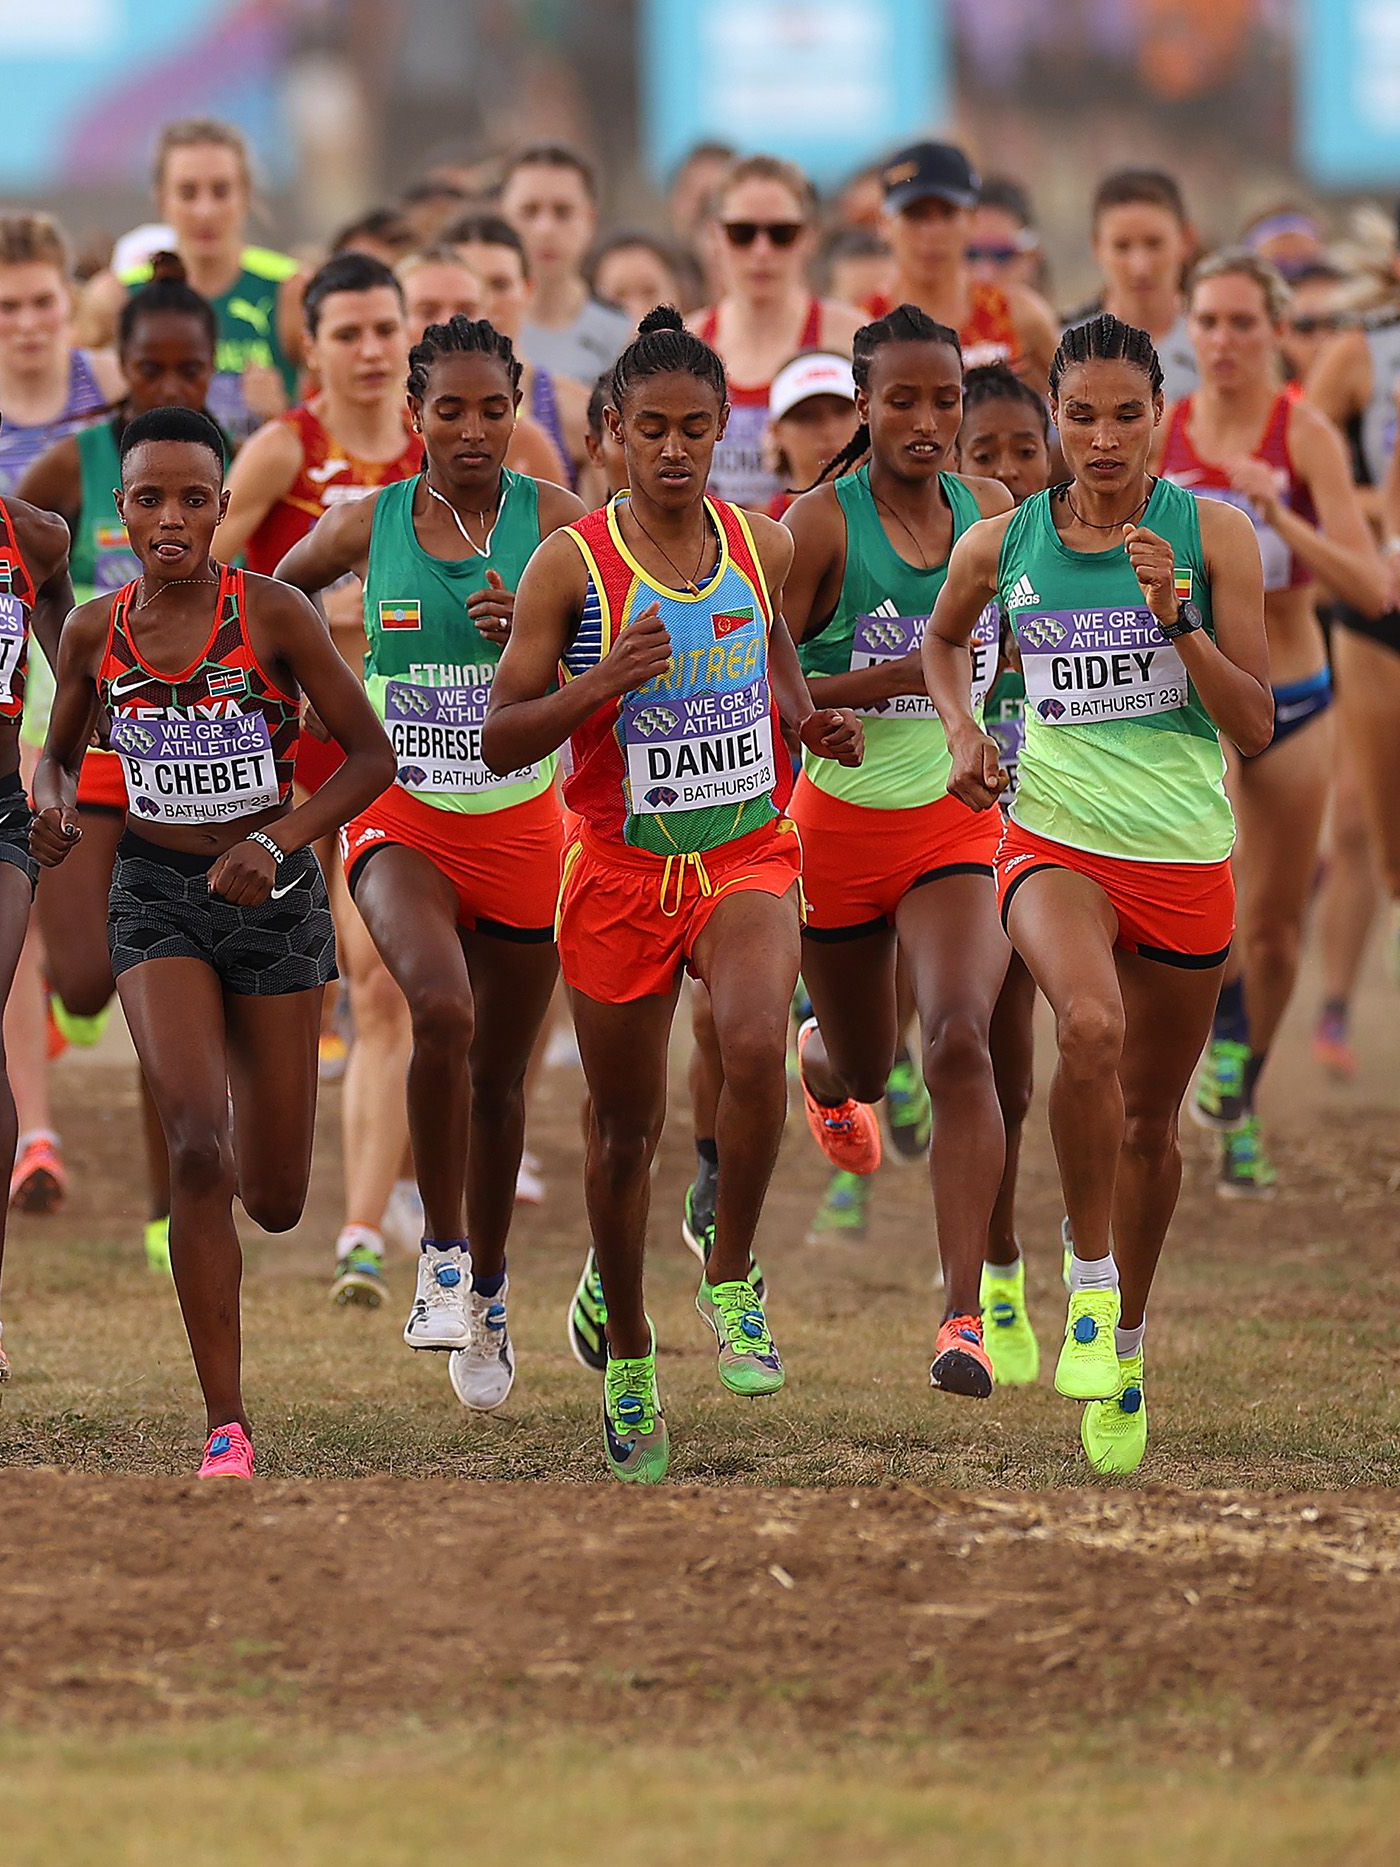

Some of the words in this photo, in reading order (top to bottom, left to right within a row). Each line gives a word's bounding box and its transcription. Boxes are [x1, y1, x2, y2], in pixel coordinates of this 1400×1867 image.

[1007, 592, 1040, 609] adidas
[1072, 613, 1104, 631] WE
[1070, 627, 1166, 649] ATHLETIC
[638, 638, 762, 693] RITREA
[1050, 650, 1156, 691] GIDEY
[436, 690, 467, 706] WE
[684, 698, 716, 717] WE
[1070, 692, 1156, 718] BATHURST
[1160, 687, 1179, 706] 23
[682, 698, 765, 736] ATHLETICS
[159, 732, 265, 757] ATHLETICS
[160, 724, 192, 740] WE
[392, 724, 481, 762] GEBRESE
[647, 728, 763, 781] DANIEL
[126, 756, 150, 791] B.
[154, 754, 265, 796] CHEBET
[683, 772, 760, 802] BATHURST
[760, 766, 772, 786] 23
[164, 799, 247, 818] BATHURST
[250, 794, 271, 807] 23
